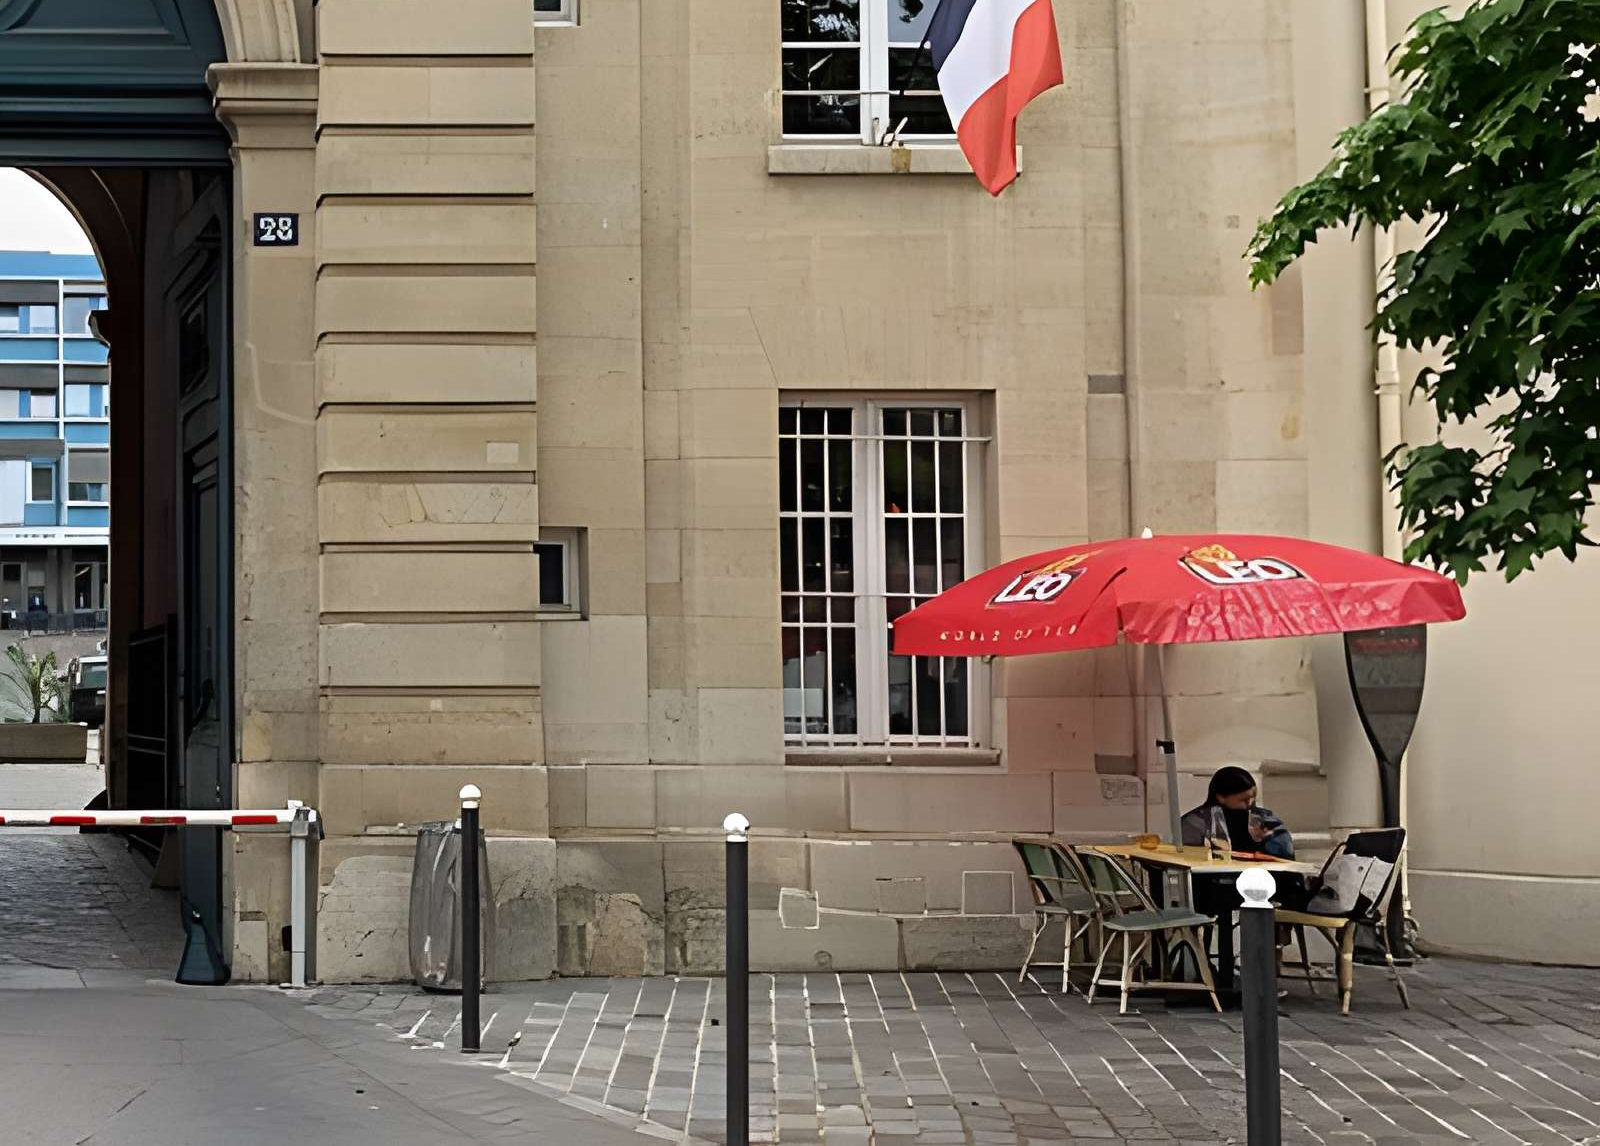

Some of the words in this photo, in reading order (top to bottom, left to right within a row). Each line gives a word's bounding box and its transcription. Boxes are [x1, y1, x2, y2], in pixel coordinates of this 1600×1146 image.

[258, 216, 294, 242] 28
[1181, 556, 1301, 585] LEO
[994, 570, 1073, 604] LEO
